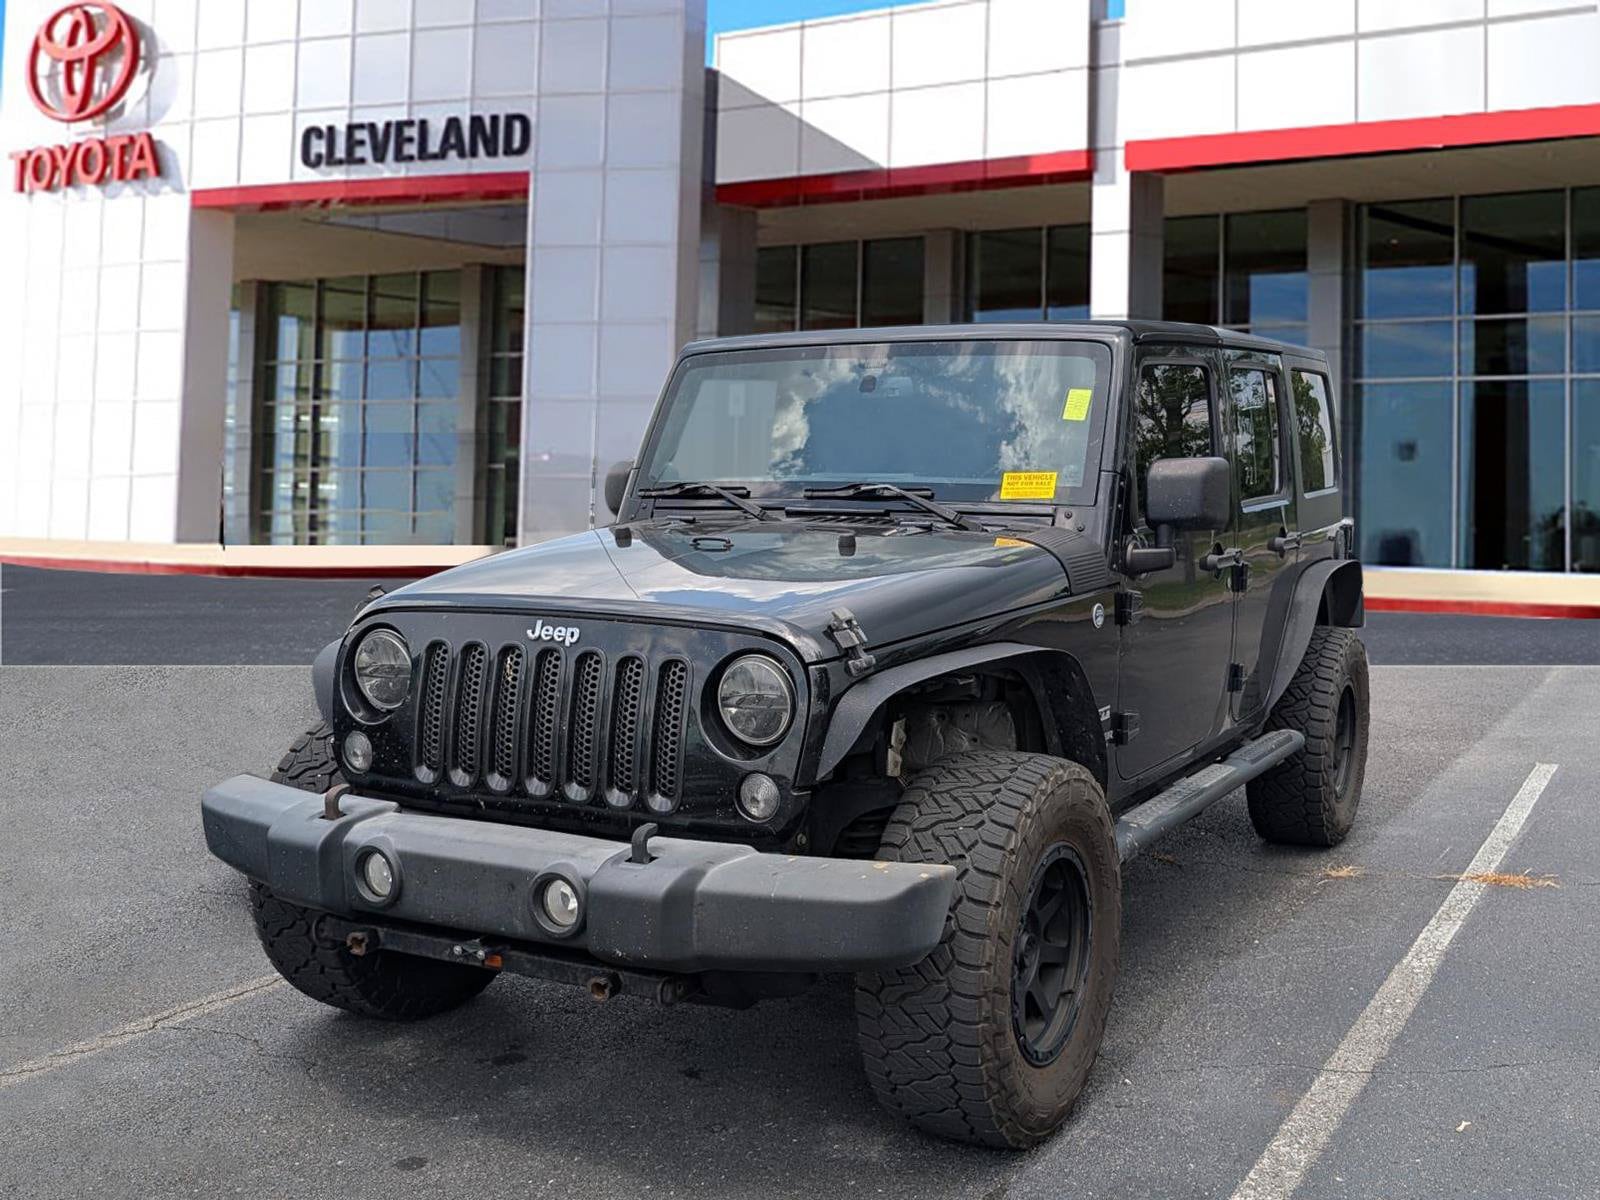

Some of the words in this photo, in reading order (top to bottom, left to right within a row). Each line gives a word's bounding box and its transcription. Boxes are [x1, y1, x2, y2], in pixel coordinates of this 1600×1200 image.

[9, 131, 161, 193] TOYOTA
[301, 113, 531, 170] CLEVELAND
[1024, 473, 1054, 481] VEHICLE
[526, 619, 580, 647] Jeep
